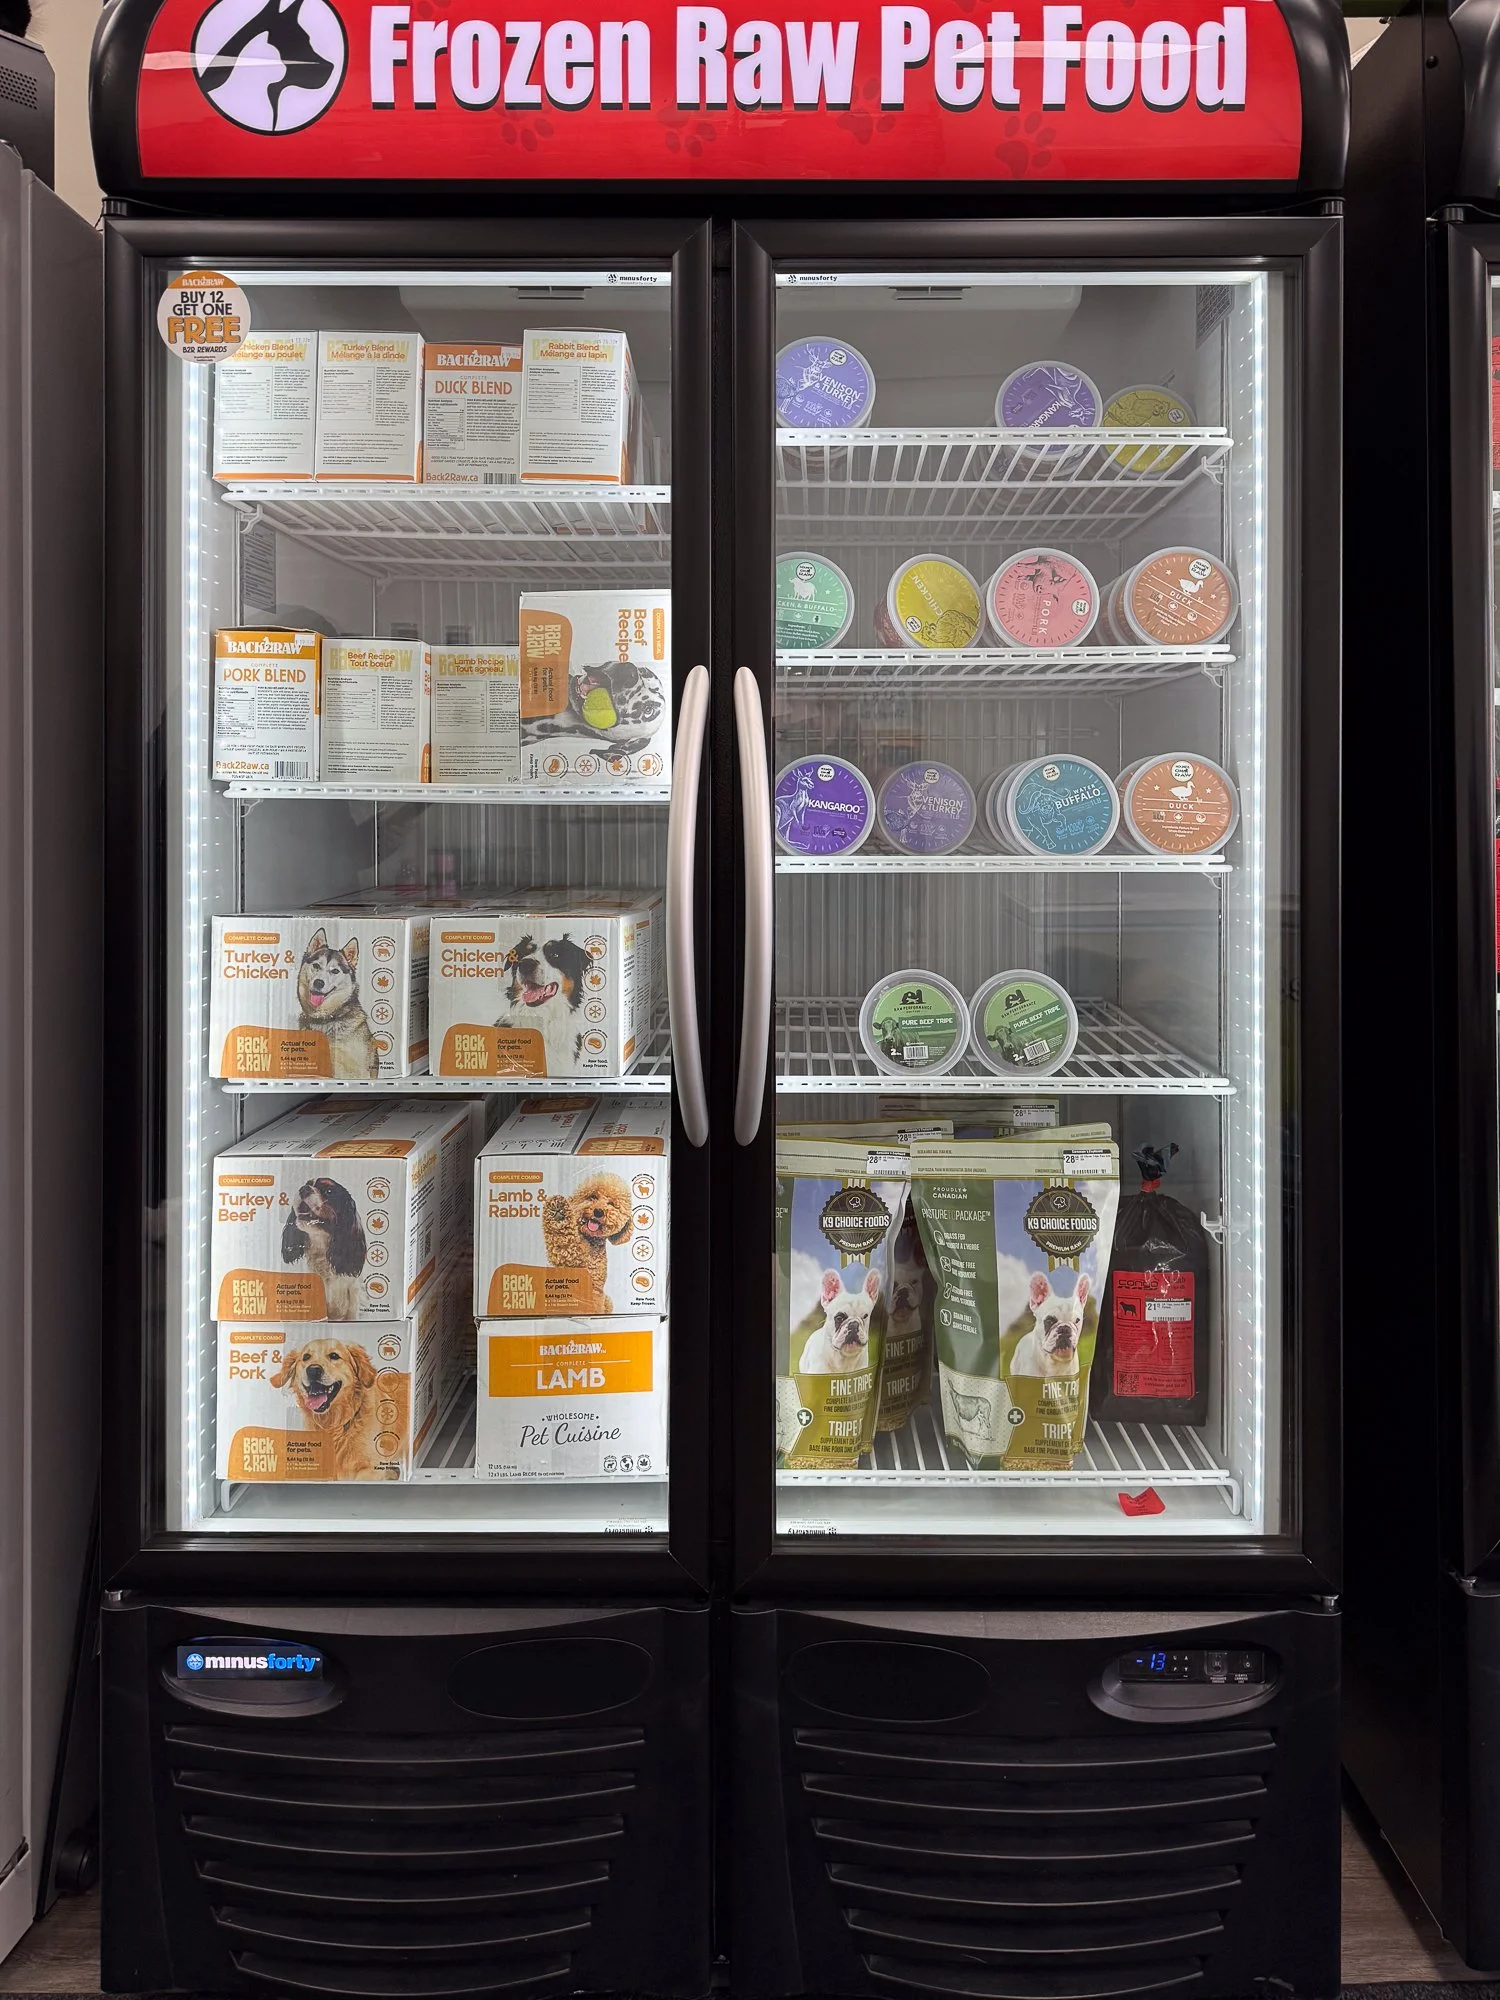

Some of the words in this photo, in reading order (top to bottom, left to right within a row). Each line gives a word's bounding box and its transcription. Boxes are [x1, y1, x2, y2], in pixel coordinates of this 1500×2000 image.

[370, 5, 651, 107] Frozen
[676, 6, 859, 107] Raw
[880, 5, 1021, 107] Pet
[1042, 5, 1247, 107] Food
[180, 291, 206, 303] BUY
[210, 290, 224, 303] 12
[172, 304, 198, 316] GET
[202, 303, 232, 316] ONE
[167, 316, 241, 344] FREE
[343, 343, 369, 353] Turkey
[548, 342, 575, 351] Rabbit
[576, 343, 600, 351] Blend
[276, 351, 303, 360] poulet
[331, 351, 365, 360] Mélange
[436, 350, 511, 367] BACK2RAW
[540, 350, 575, 359] Mélange
[589, 351, 607, 359] lapin
[435, 381, 469, 395] DUCK
[471, 381, 513, 395] BLEND
[819, 373, 860, 399] VENISON
[821, 383, 857, 406] TURKEY
[425, 473, 479, 482] Back2Raw.ca
[911, 575, 943, 617] CHICKEN
[1168, 590, 1194, 607] DUCK
[804, 603, 835, 612] BUFFALO
[1038, 600, 1051, 635] PORK
[633, 608, 648, 646] Beef
[615, 608, 632, 663] Recipe
[227, 636, 302, 654] BACK2RAW
[348, 652, 367, 660] Beef
[368, 653, 395, 662] Recipe
[350, 660, 368, 668] Tout
[478, 658, 504, 666] Recipe
[223, 668, 260, 682] PORK
[265, 668, 306, 682] BLEND
[1073, 783, 1096, 795] WATER
[808, 799, 861, 813] KANGAROO
[922, 795, 964, 808] VENISON
[1055, 788, 1101, 810] BUFFALO
[928, 804, 962, 815] TURKEY
[224, 950, 280, 966] Turkey
[284, 950, 295, 963] &
[441, 949, 504, 963] Chicken
[507, 949, 519, 963] &
[224, 965, 289, 979] Chicken
[441, 964, 504, 978] Chicken
[1013, 1018, 1029, 1029] PURE
[1029, 1012, 1043, 1022] BEEF
[1044, 1005, 1061, 1016] TRIPE
[219, 1192, 275, 1209] Turkey
[278, 1192, 290, 1206] &
[489, 1189, 533, 1203] Lamb
[537, 1189, 548, 1203] &
[219, 1209, 256, 1221] Beef
[488, 1205, 540, 1218] Rabbit
[822, 1216, 834, 1228] K9
[835, 1216, 863, 1228] CHOICE
[864, 1215, 890, 1227] FOODS
[1028, 1218, 1039, 1230] K9
[1041, 1218, 1070, 1230] CHOICE
[1071, 1218, 1097, 1230] FOODS
[839, 1239, 862, 1248] PREMIUM
[862, 1238, 874, 1247] RAW
[1046, 1241, 1070, 1251] PREMIUM
[1070, 1241, 1082, 1250] RAW
[229, 1350, 268, 1364] Beef
[272, 1350, 283, 1363] &
[229, 1366, 266, 1380] Pork
[537, 1368, 606, 1390] LAMB
[830, 1379, 851, 1396] FINE
[853, 1373, 872, 1394] TRIPE
[886, 1377, 910, 1397] TRIPE
[1042, 1382, 1062, 1399] FINE
[546, 1413, 595, 1421] WHOLESOME
[520, 1425, 549, 1447] Pet
[554, 1423, 621, 1445] Cuisine
[828, 1420, 857, 1437] TRIPE
[1042, 1422, 1072, 1440] TRIPE
[205, 1653, 316, 1672] minusforty
